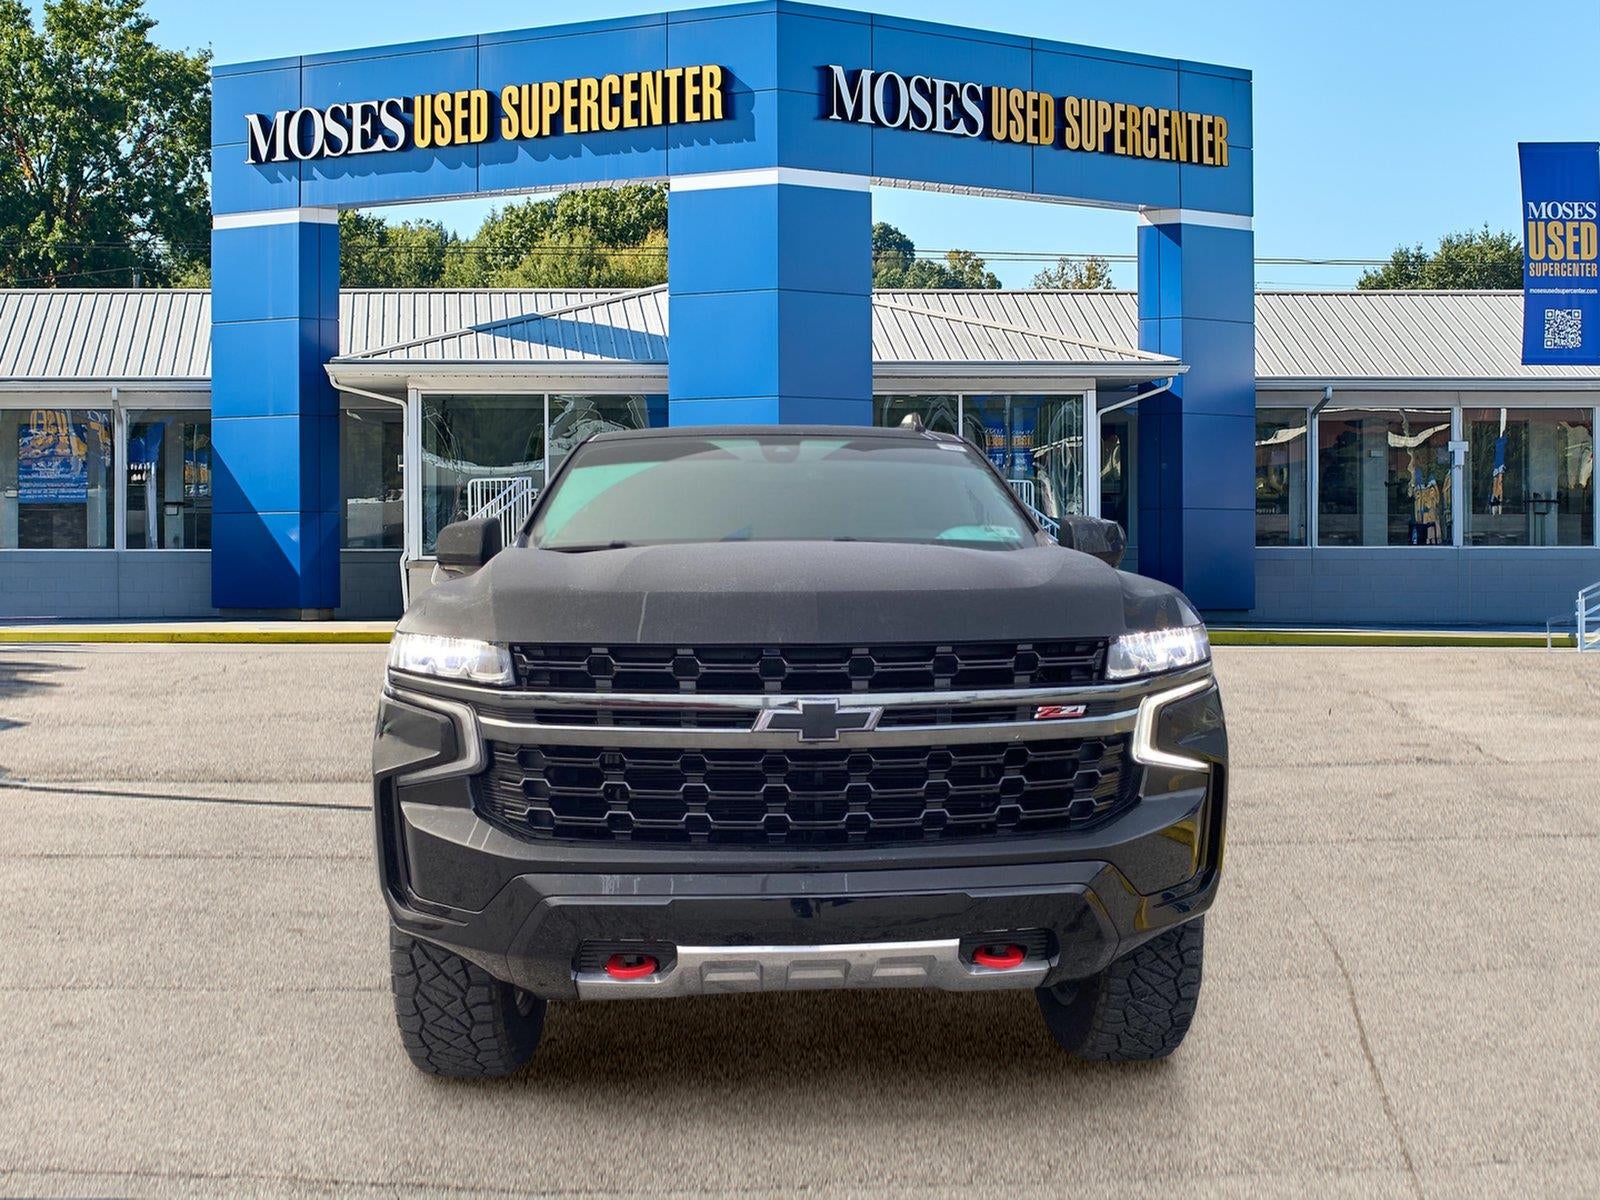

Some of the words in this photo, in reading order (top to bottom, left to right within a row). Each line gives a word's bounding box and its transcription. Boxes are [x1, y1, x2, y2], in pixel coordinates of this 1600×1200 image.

[244, 97, 407, 165] MOSES
[413, 89, 489, 149] USED
[500, 64, 724, 141] SUPERCENTER
[828, 65, 985, 138] MOSES
[991, 86, 1055, 146] USED
[1065, 95, 1230, 167] SUPERCENTER
[1527, 201, 1597, 220] MOSES
[1528, 221, 1598, 261] USED
[1529, 262, 1598, 278] SUPERCENTER
